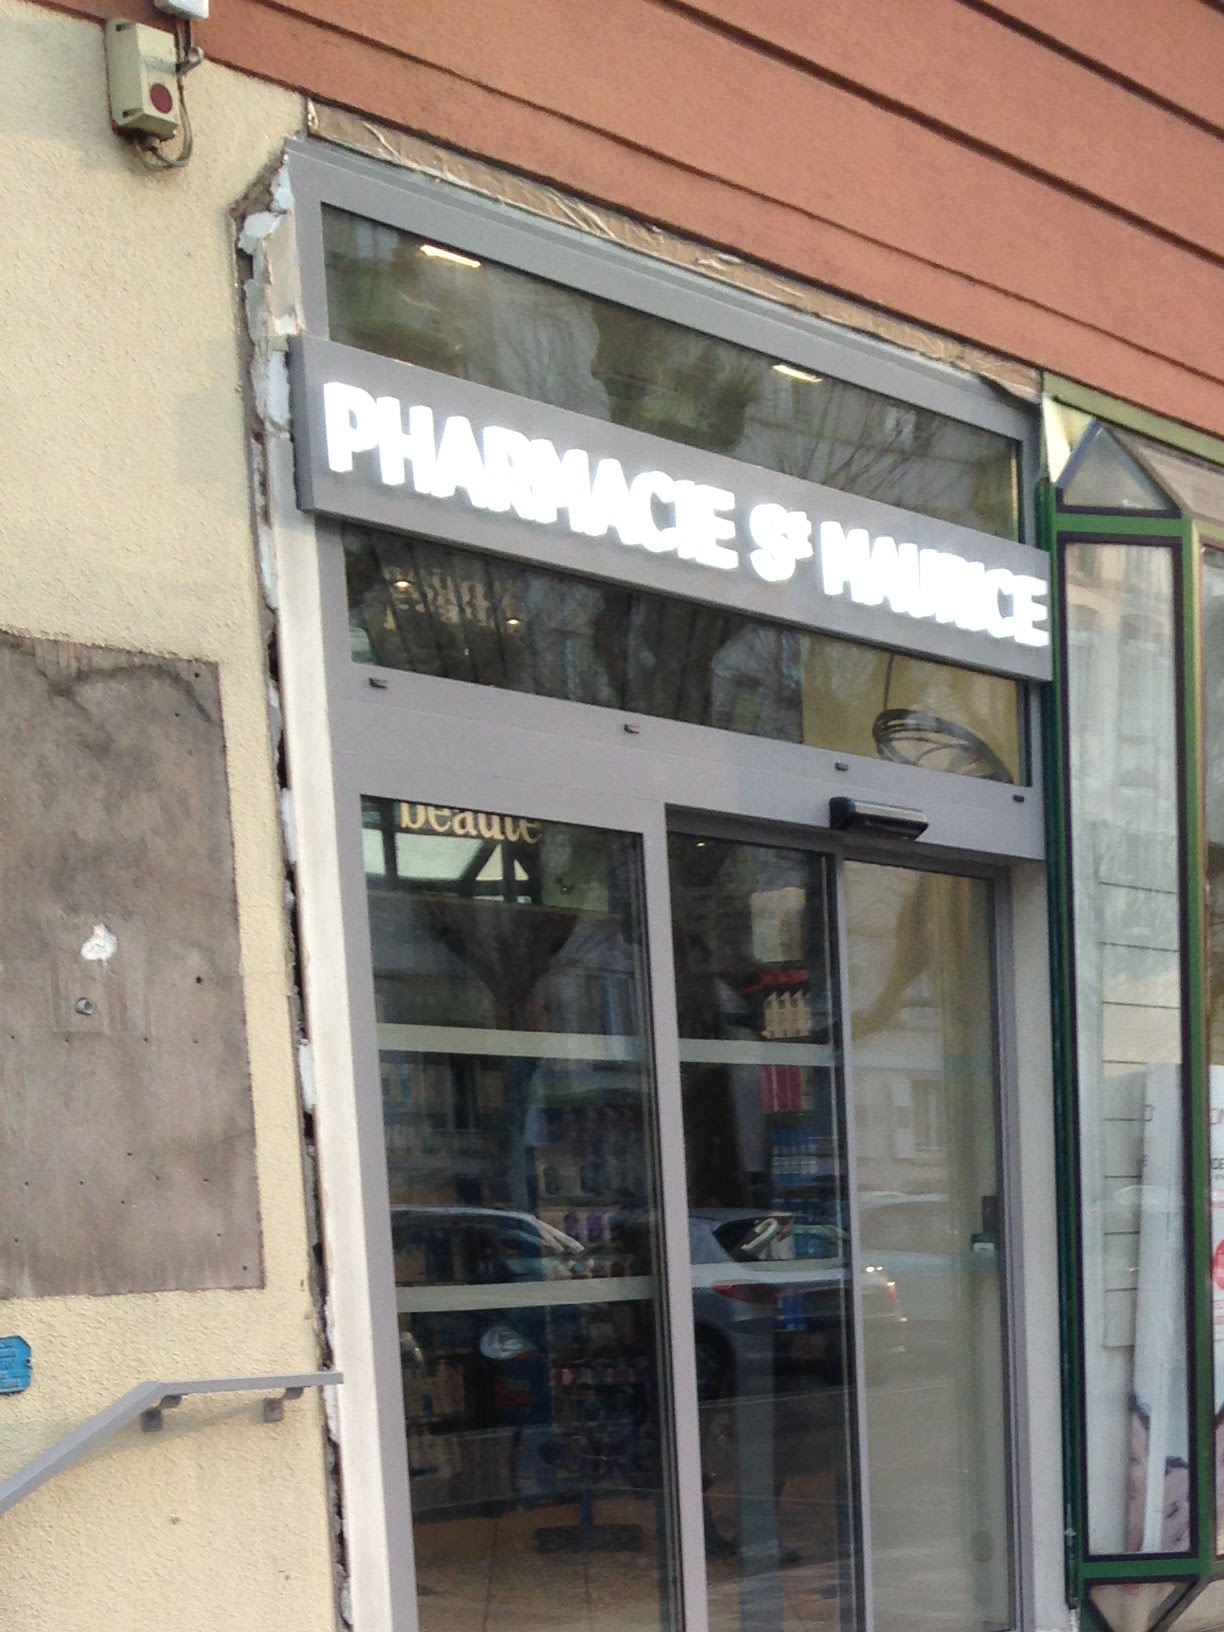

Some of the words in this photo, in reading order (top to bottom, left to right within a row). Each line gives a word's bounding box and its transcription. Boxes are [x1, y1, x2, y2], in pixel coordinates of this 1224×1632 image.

[323, 381, 739, 570] PHARMACIE
[749, 503, 813, 582] St
[820, 521, 1049, 647] MAURICE
